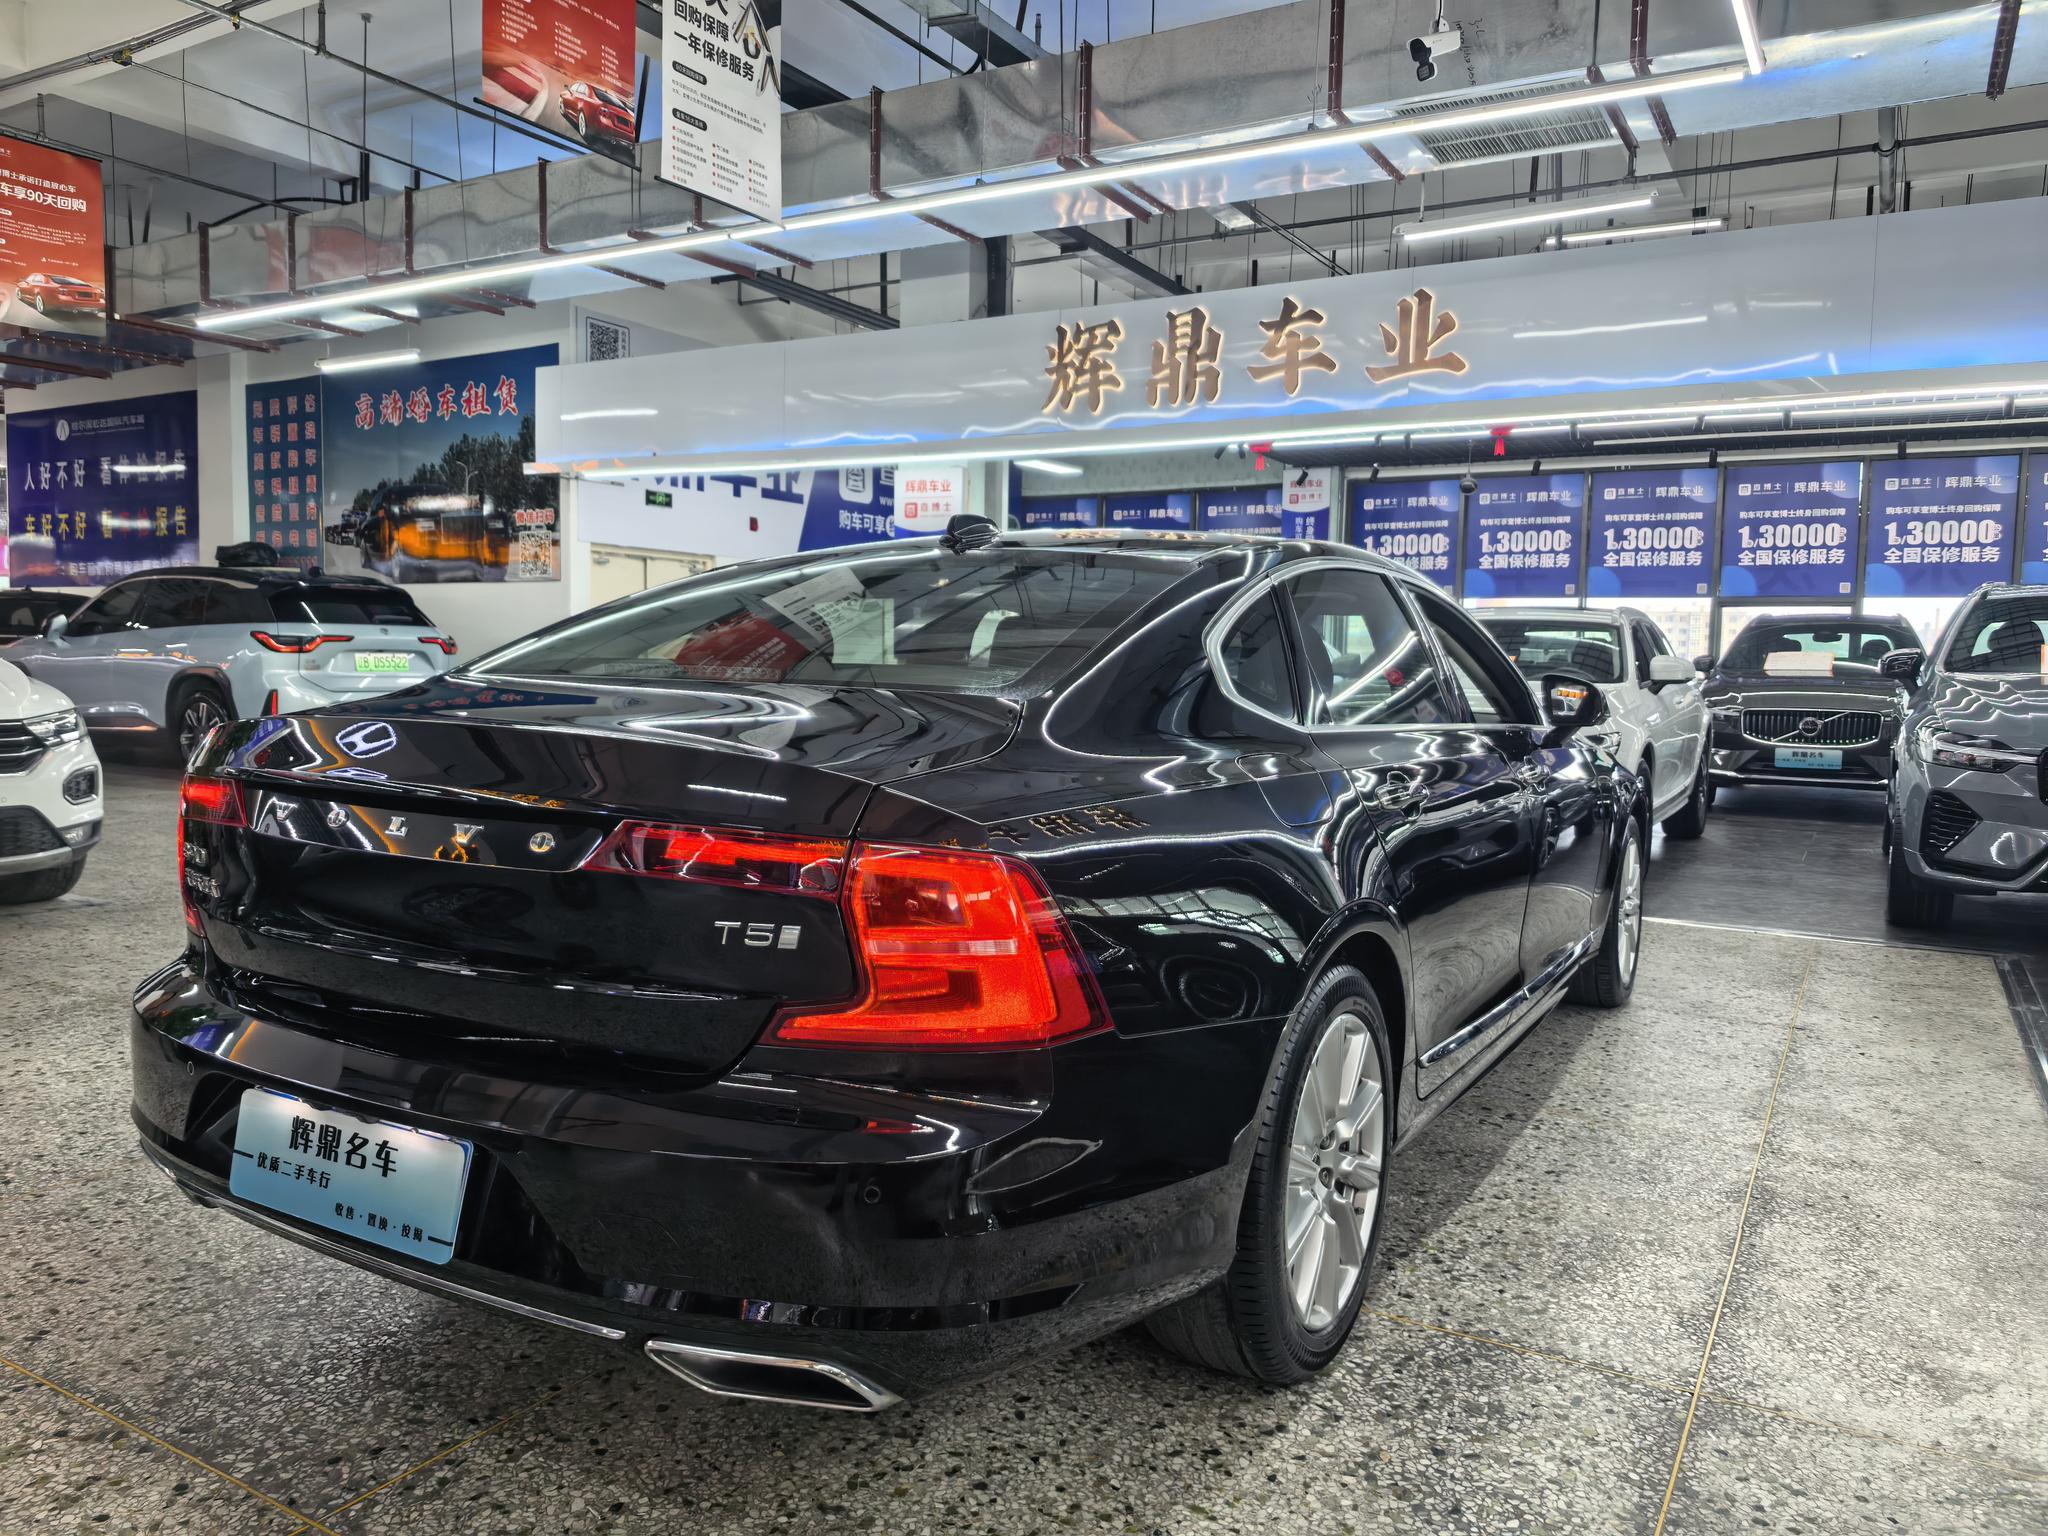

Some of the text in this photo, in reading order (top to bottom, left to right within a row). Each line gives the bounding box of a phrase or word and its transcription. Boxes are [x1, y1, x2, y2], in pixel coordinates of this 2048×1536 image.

[674, 0, 729, 42] 回购保障
[674, 31, 755, 81] 一年保修服务
[0, 169, 76, 193] 博士承诺打造放心车
[1041, 288, 1468, 414] 辉鼎车业
[355, 375, 518, 430] 高端婚车租赁
[24, 459, 86, 491] 人好不好
[905, 479, 951, 492] 辉鼎车业
[1945, 475, 2002, 488] 辉鼎车业
[1526, 490, 1571, 503] 辉鼎车业
[1656, 485, 1704, 498] 辉鼎车业
[1794, 480, 1846, 493] 辉鼎车业
[1407, 496, 1449, 507] 辉鼎车业
[1885, 504, 2001, 515] 购车可享查博士终身回购保障
[25, 511, 87, 540] 车好不好
[1603, 551, 1703, 567] 全国保修服务
[1738, 548, 1845, 566] 全国保修服务
[1884, 546, 2001, 564] 全国保修服务
[374, 656, 408, 669] DS5522
[275, 801, 557, 853] VOLVO
[714, 921, 775, 947] T5
[289, 1115, 399, 1178] 辉鼎名车
[257, 1151, 331, 1190] 优质二手车行
